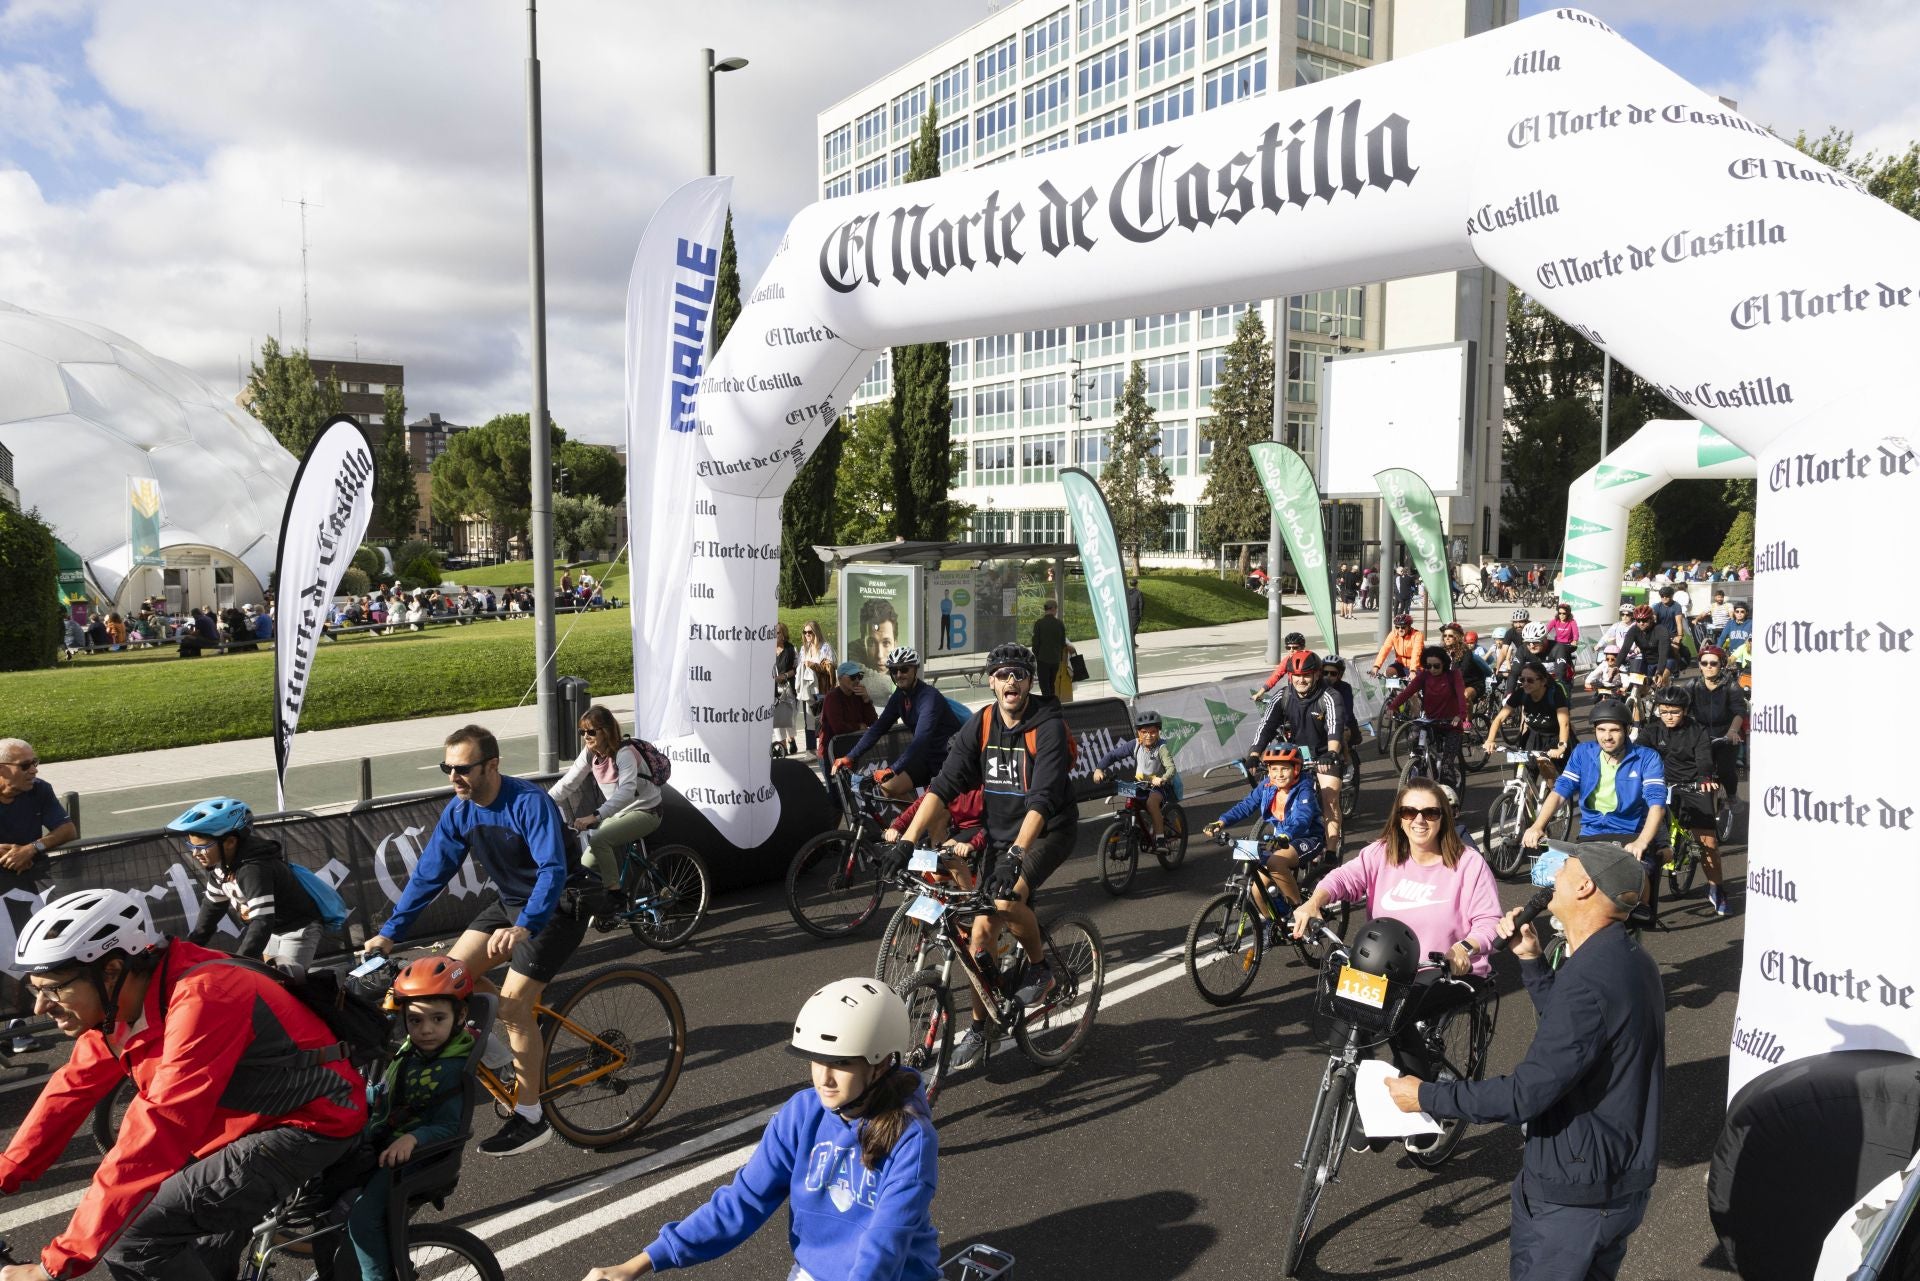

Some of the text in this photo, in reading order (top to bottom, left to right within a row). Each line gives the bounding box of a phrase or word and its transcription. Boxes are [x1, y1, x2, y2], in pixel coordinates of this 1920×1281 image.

[1507, 110, 1540, 149] El
[1547, 104, 1624, 140] Norte
[1628, 103, 1657, 125] de
[1728, 157, 1766, 180] El
[819, 99, 1420, 294] El Norte de Castilla
[1477, 189, 1560, 232] Castilla
[1536, 218, 1788, 290] El Norte de Castilla
[1730, 281, 1913, 330] El Norte de
[670, 237, 717, 433] MAHLE
[765, 325, 840, 346] El Norte d
[732, 377, 745, 392] de
[747, 372, 803, 392] Castilla
[1695, 376, 1794, 409] Castilla
[786, 406, 806, 426] El
[697, 460, 713, 477] El
[714, 459, 751, 477] Norte
[751, 455, 768, 470] de
[1769, 445, 1915, 492] El Norte de
[318, 447, 372, 566] Castilla
[708, 542, 746, 559] Norte
[747, 543, 758, 559] de
[1754, 540, 1800, 574] astilla
[859, 586, 897, 596] PARADIGME
[706, 624, 742, 641] Norte
[744, 626, 756, 641] de
[949, 614, 967, 649] B
[1765, 620, 1915, 654] El Norte de
[703, 706, 740, 723] Norte
[742, 707, 756, 723] de
[1750, 704, 1799, 736] astilla
[685, 788, 703, 803] El
[704, 788, 742, 805] Norte
[742, 789, 756, 804] de
[1764, 785, 1915, 831] El Norte de
[1392, 879, 1437, 900] NIKE
[1342, 979, 1381, 1001] 1165
[1760, 949, 1915, 1010] El Norte de
